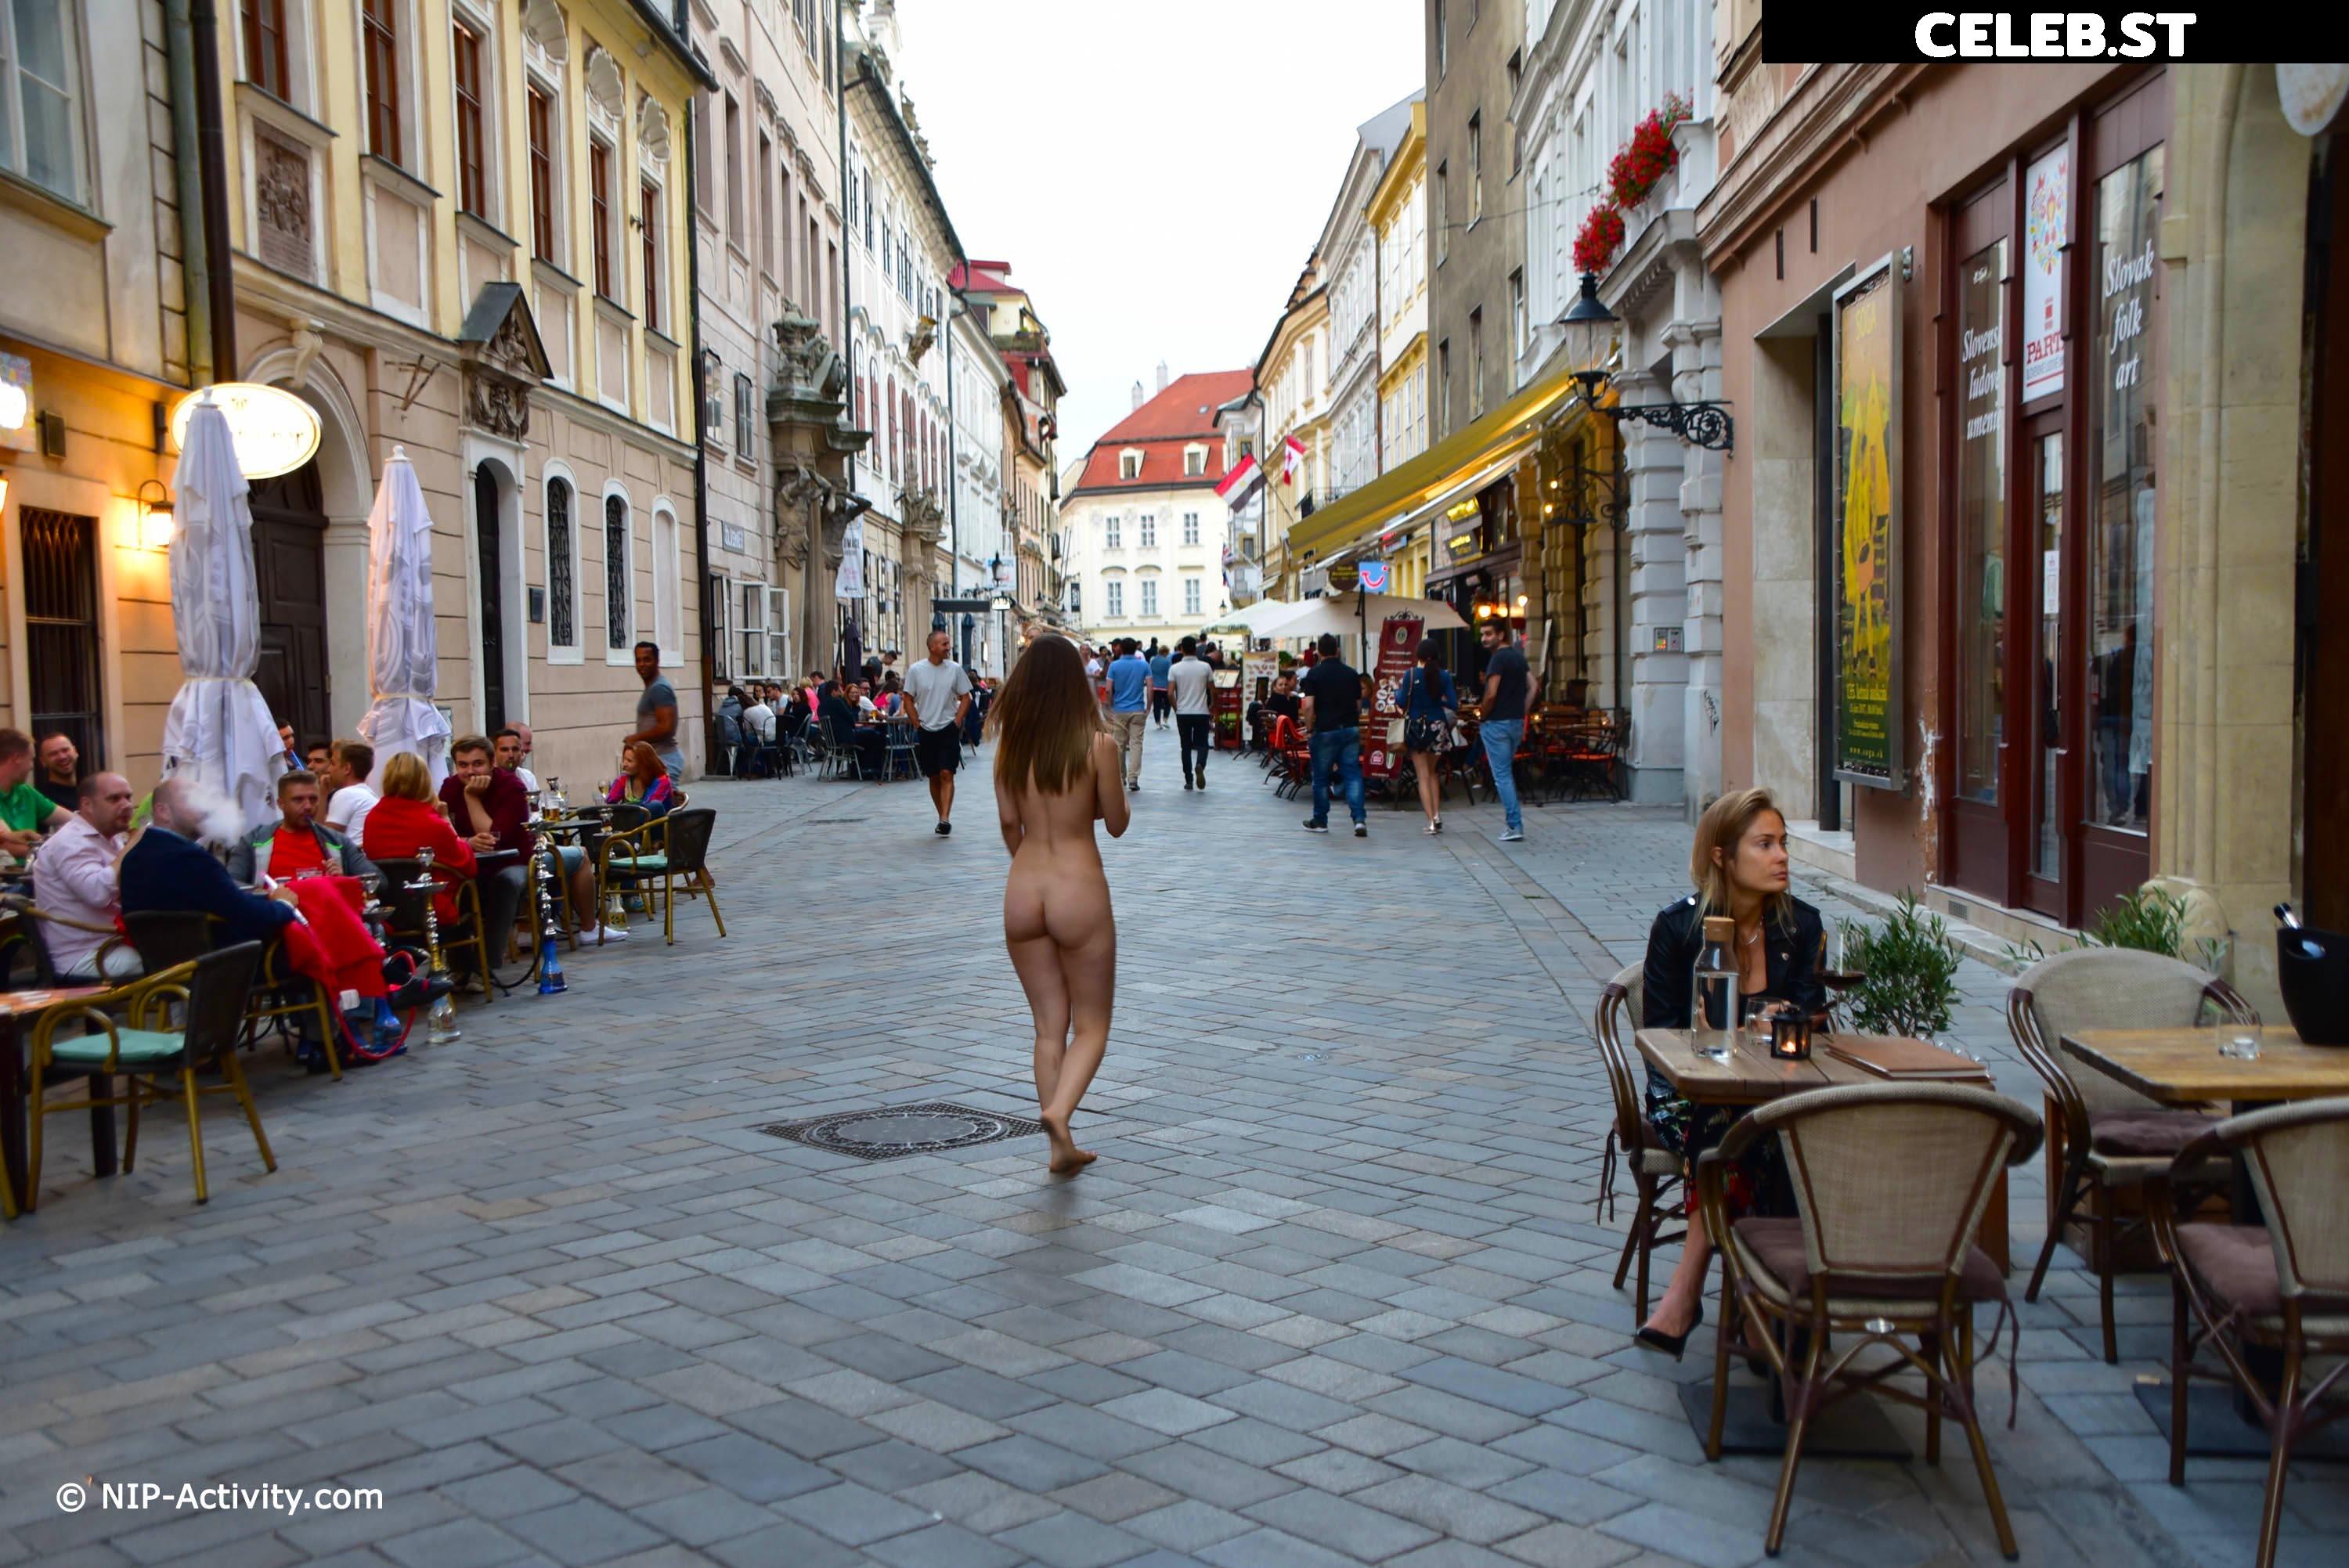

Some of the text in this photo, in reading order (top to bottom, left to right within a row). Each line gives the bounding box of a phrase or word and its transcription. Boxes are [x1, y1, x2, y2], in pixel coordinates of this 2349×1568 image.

[2105, 238, 2154, 298] Slovak
[2110, 296, 2143, 355] folk
[2116, 353, 2140, 391] art
